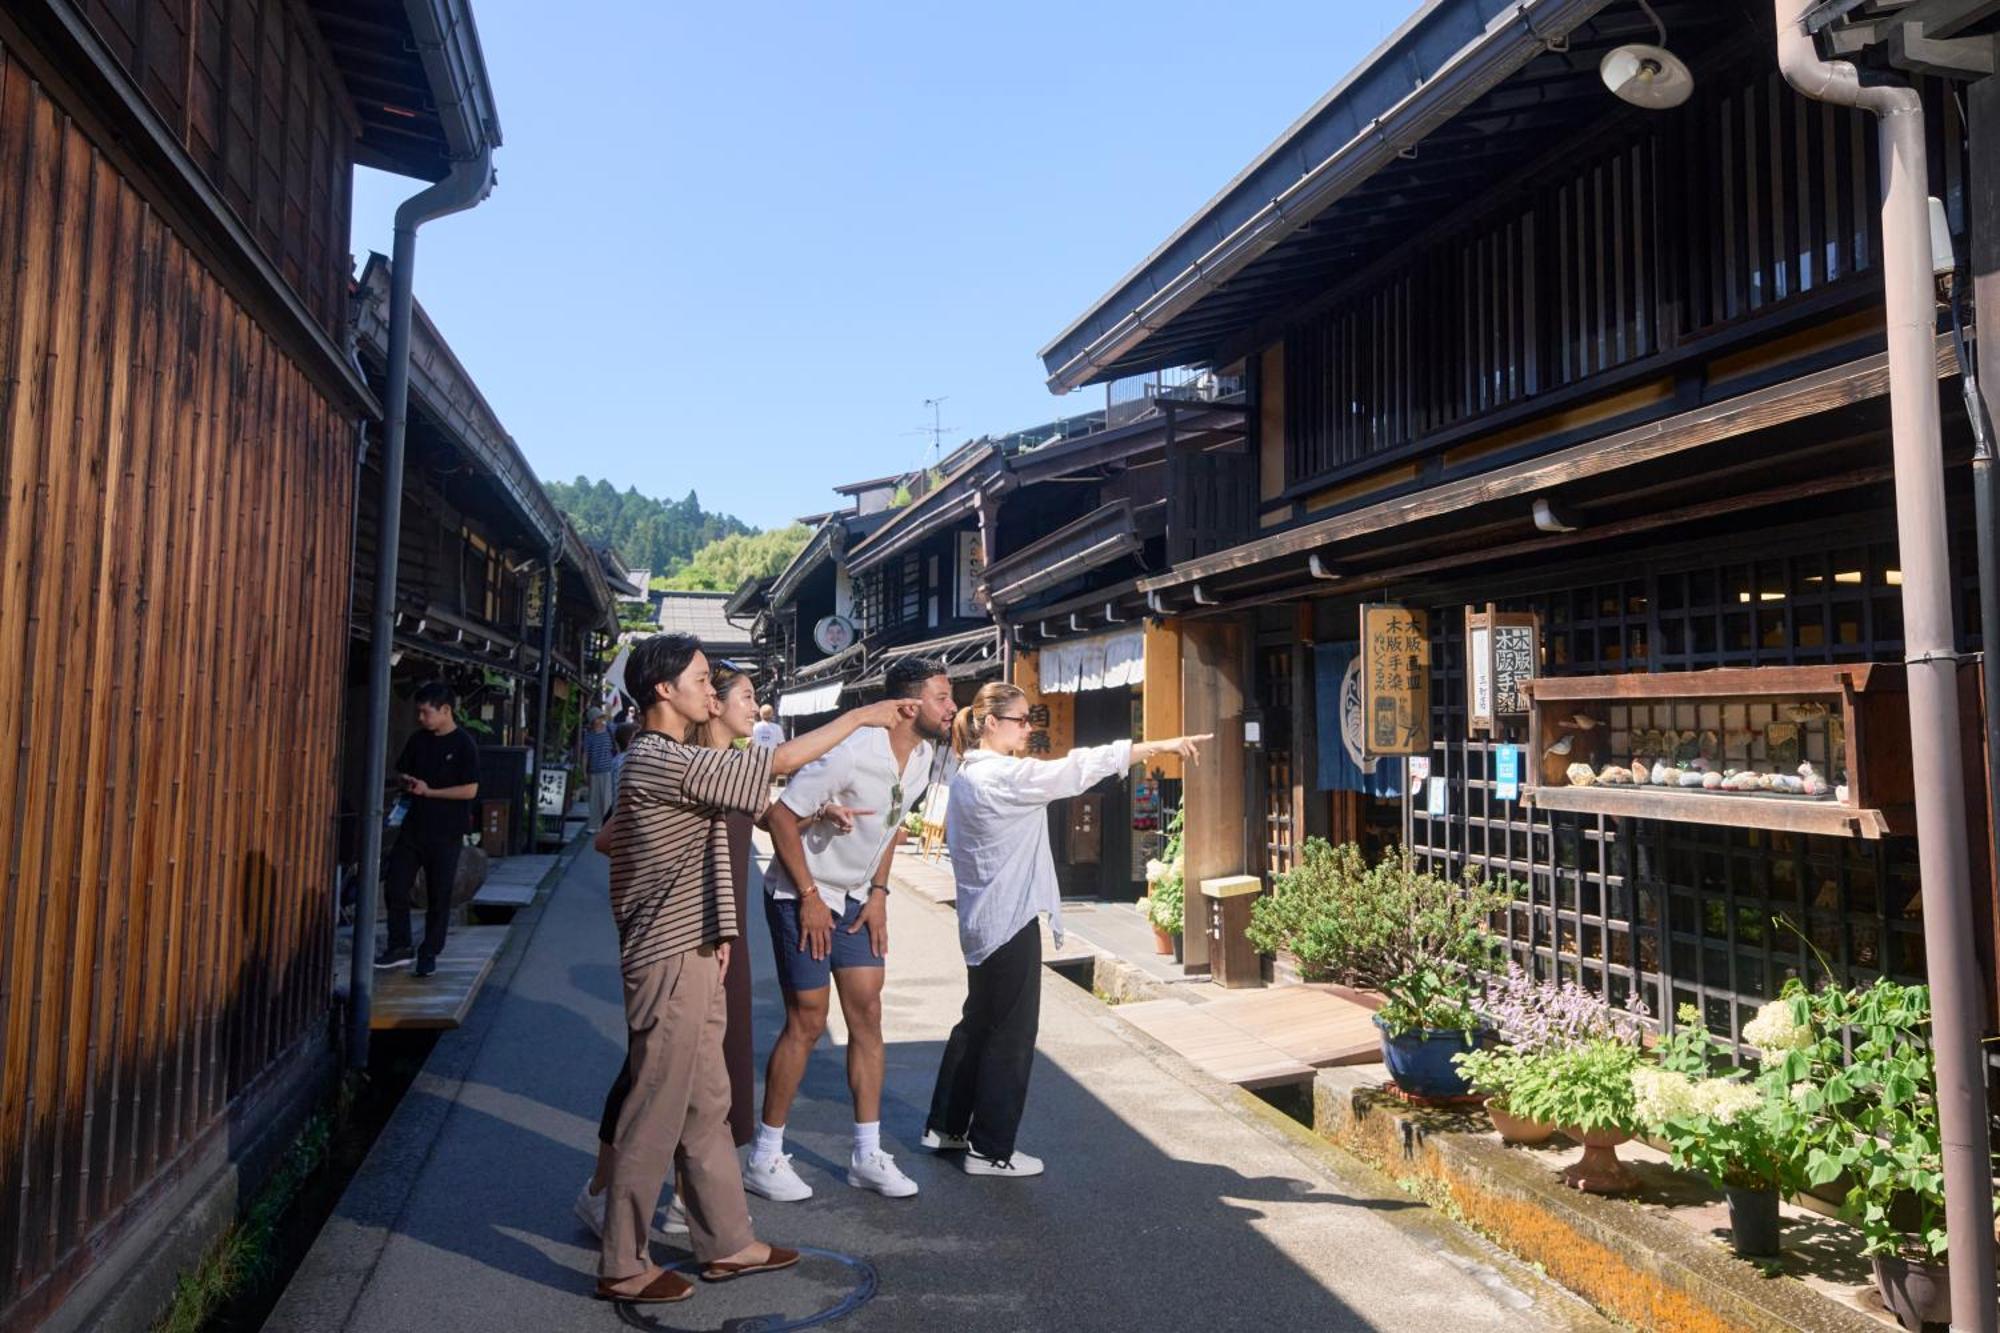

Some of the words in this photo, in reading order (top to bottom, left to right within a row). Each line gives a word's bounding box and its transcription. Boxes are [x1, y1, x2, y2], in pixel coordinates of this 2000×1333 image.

[1386, 615, 1404, 691] 木版手染
[1496, 629, 1515, 713] 木版手染
